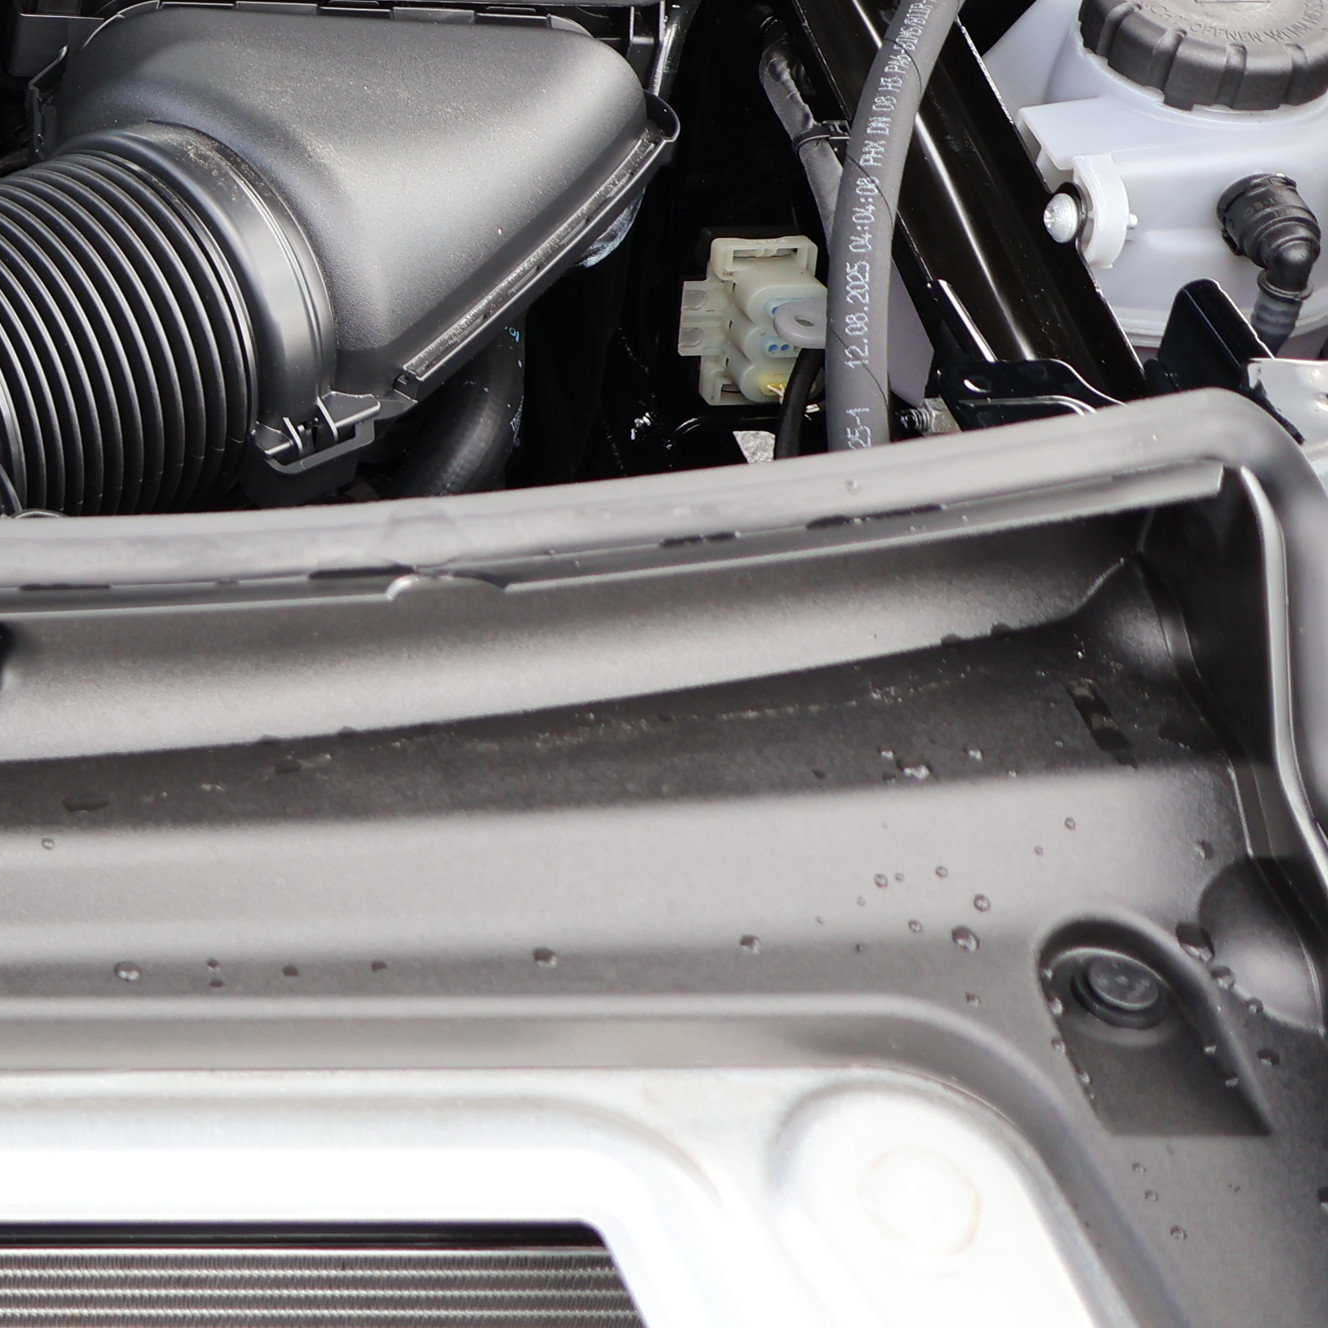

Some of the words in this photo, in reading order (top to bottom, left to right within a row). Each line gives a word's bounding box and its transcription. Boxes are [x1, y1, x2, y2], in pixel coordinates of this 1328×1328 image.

[871, 94, 897, 112] 08
[859, 139, 886, 167] PHX
[848, 175, 879, 254] 04:04:08
[844, 261, 871, 370] 12.08.2025
